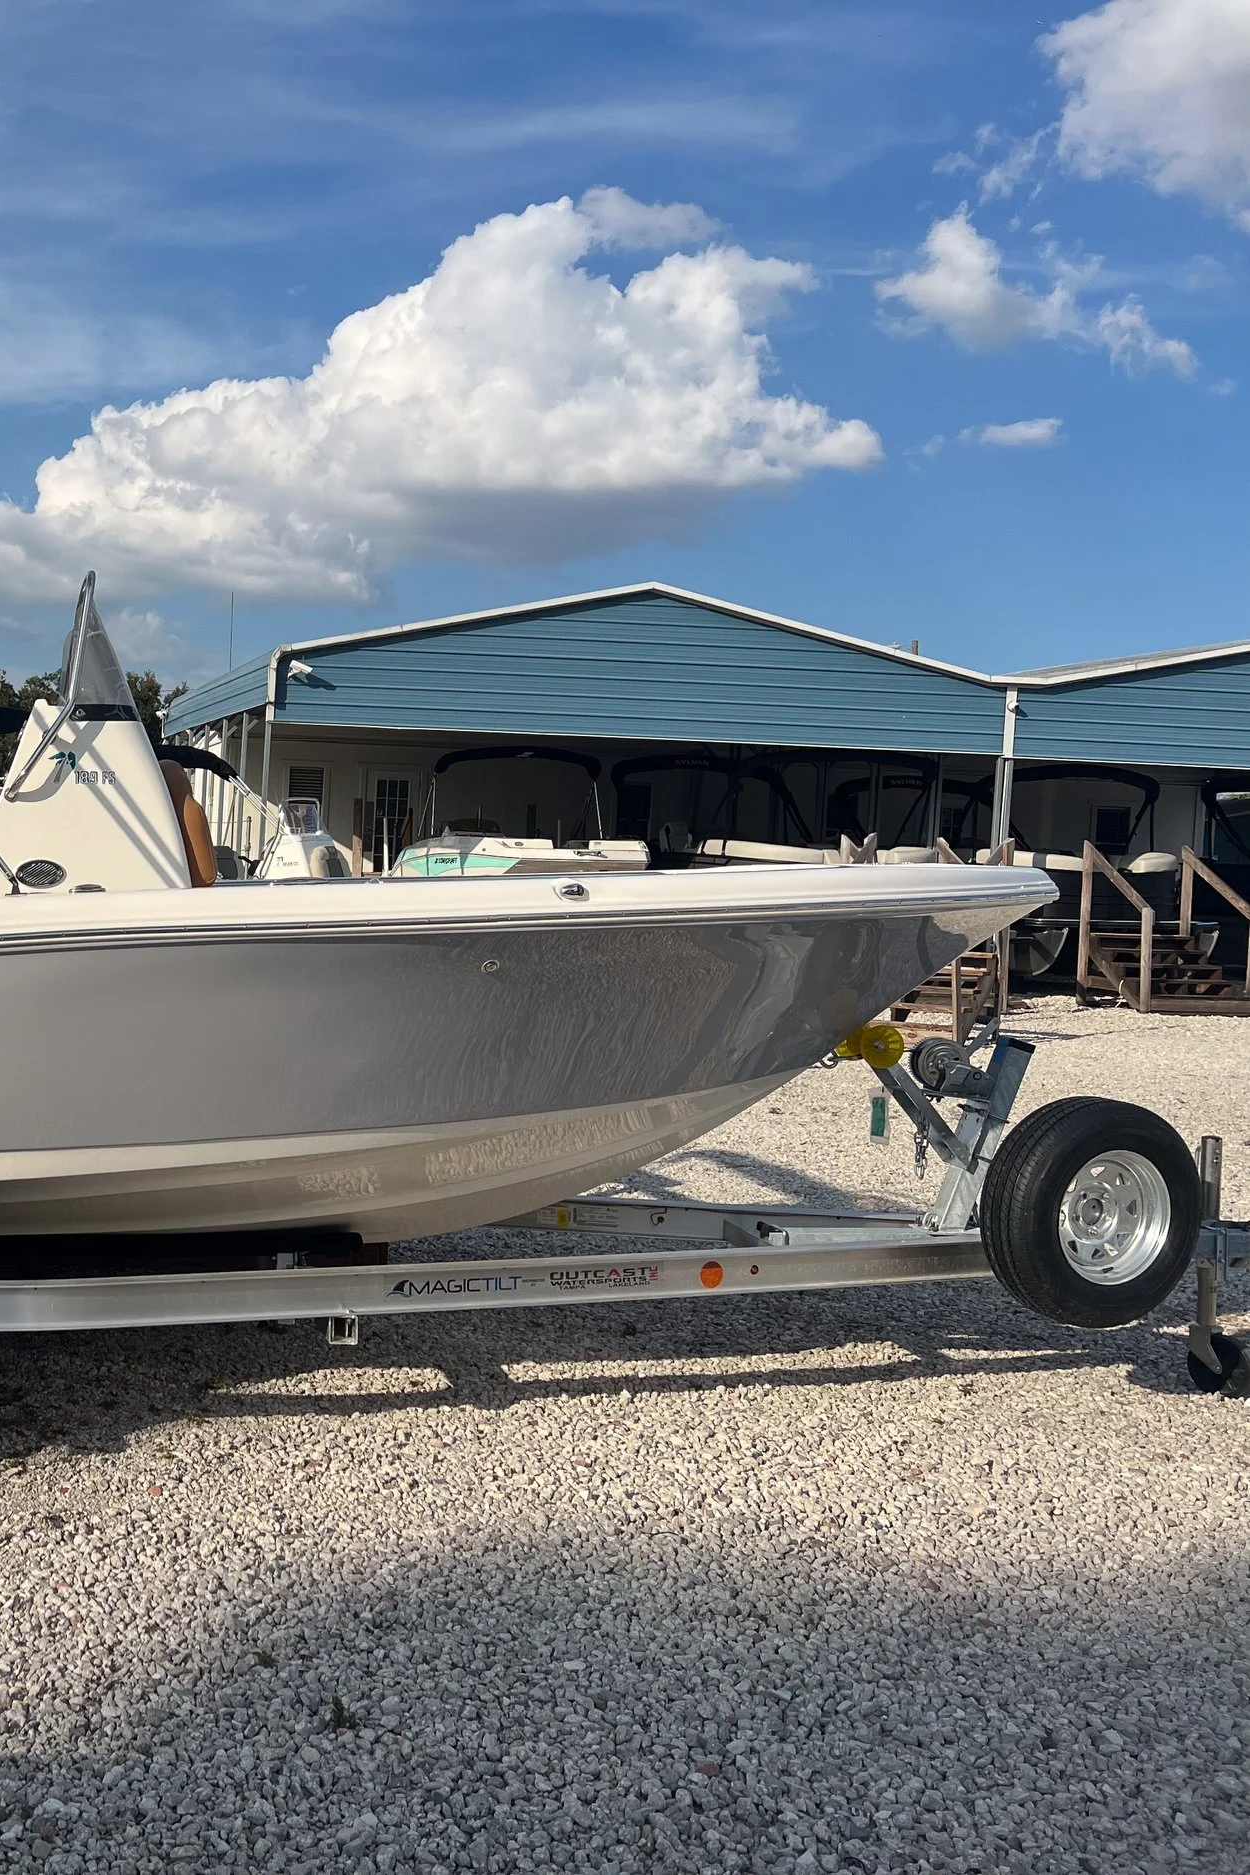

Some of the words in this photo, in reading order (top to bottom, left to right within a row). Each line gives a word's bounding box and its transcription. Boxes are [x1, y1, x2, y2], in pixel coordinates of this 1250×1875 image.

[73, 771, 99, 785] 189
[102, 771, 116, 785] FS
[550, 1266, 650, 1281] OUTCAST
[409, 1276, 523, 1296] MAGICTILT
[550, 1276, 647, 1287] WATERSPORTS
